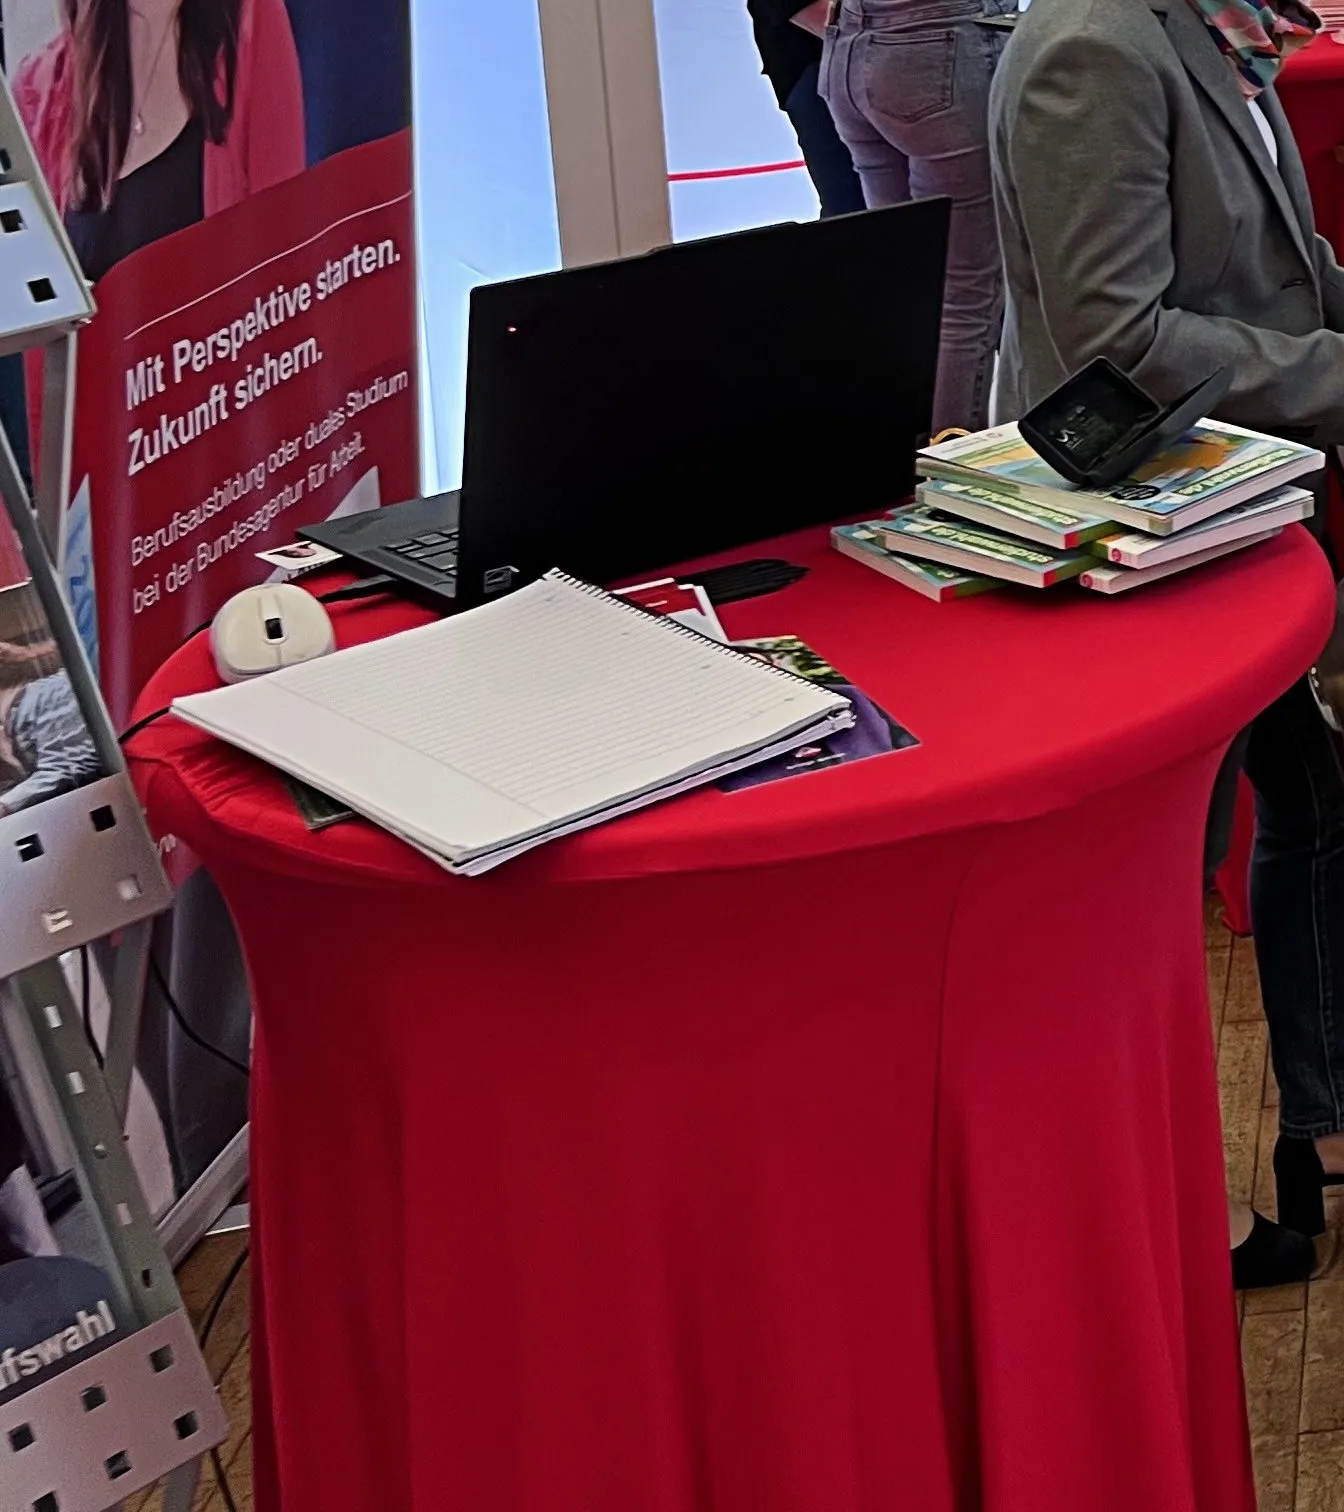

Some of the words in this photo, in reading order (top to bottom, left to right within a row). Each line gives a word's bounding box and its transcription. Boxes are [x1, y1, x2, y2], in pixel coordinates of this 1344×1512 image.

[125, 356, 164, 411] Mit
[172, 283, 311, 384] Perspektive
[316, 238, 401, 301] starten.
[128, 384, 228, 476] Zukunft
[234, 335, 324, 411] sichern.
[131, 465, 266, 567] Berufsausbildung
[267, 436, 301, 478] oder
[304, 404, 346, 450] duales
[346, 371, 409, 416] Studium
[133, 574, 161, 615] bei
[165, 557, 195, 601] der
[196, 486, 304, 573] Bundesagentur
[307, 466, 326, 494] für
